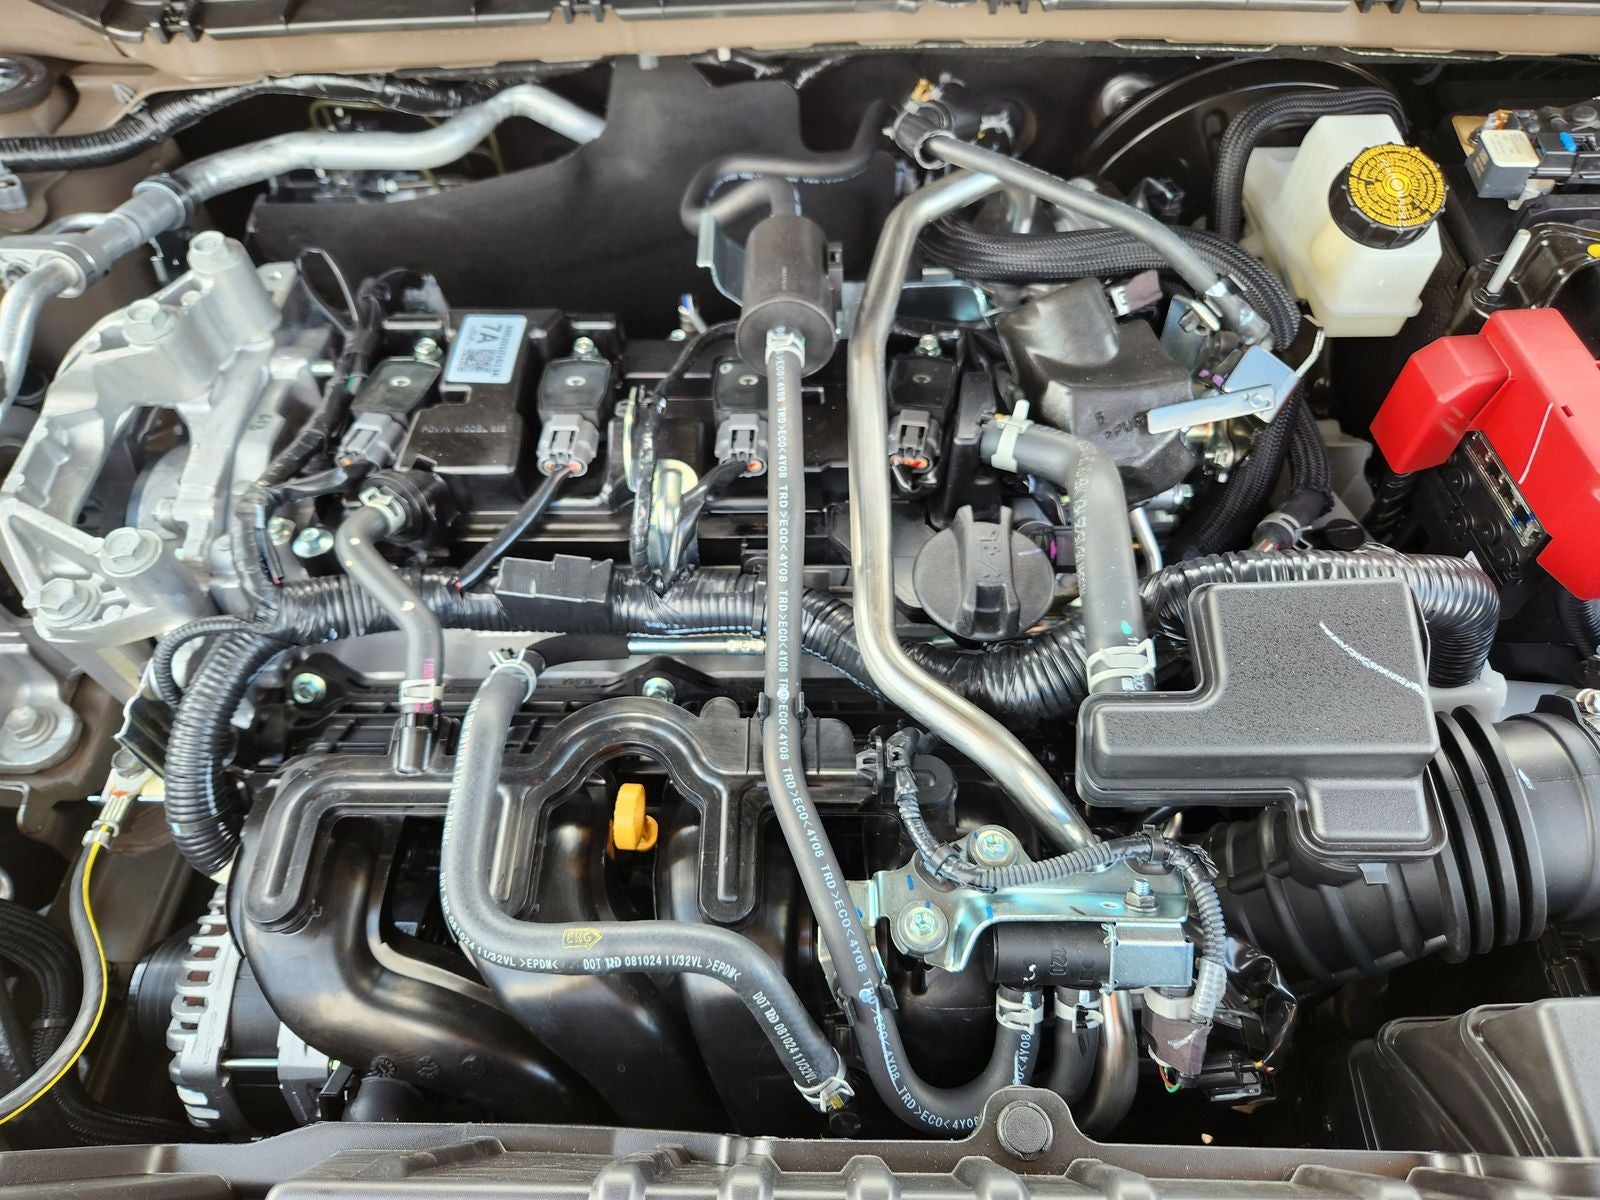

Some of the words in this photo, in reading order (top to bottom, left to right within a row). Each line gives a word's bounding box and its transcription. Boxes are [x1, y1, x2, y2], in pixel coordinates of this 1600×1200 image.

[477, 325, 502, 344] 7A
[778, 485, 789, 583] TRD>ECO<4Y08
[778, 590, 789, 673] TRD>ECO<4Y08
[782, 766, 825, 858] TRD>ECO<4Y08
[820, 863, 868, 973] TRD>ECO<4Y08
[583, 958, 601, 971] DOT
[625, 954, 662, 968] 081024
[706, 957, 743, 982] >EPDM<
[752, 990, 771, 1009] DOT
[773, 1022, 800, 1054] 081024
